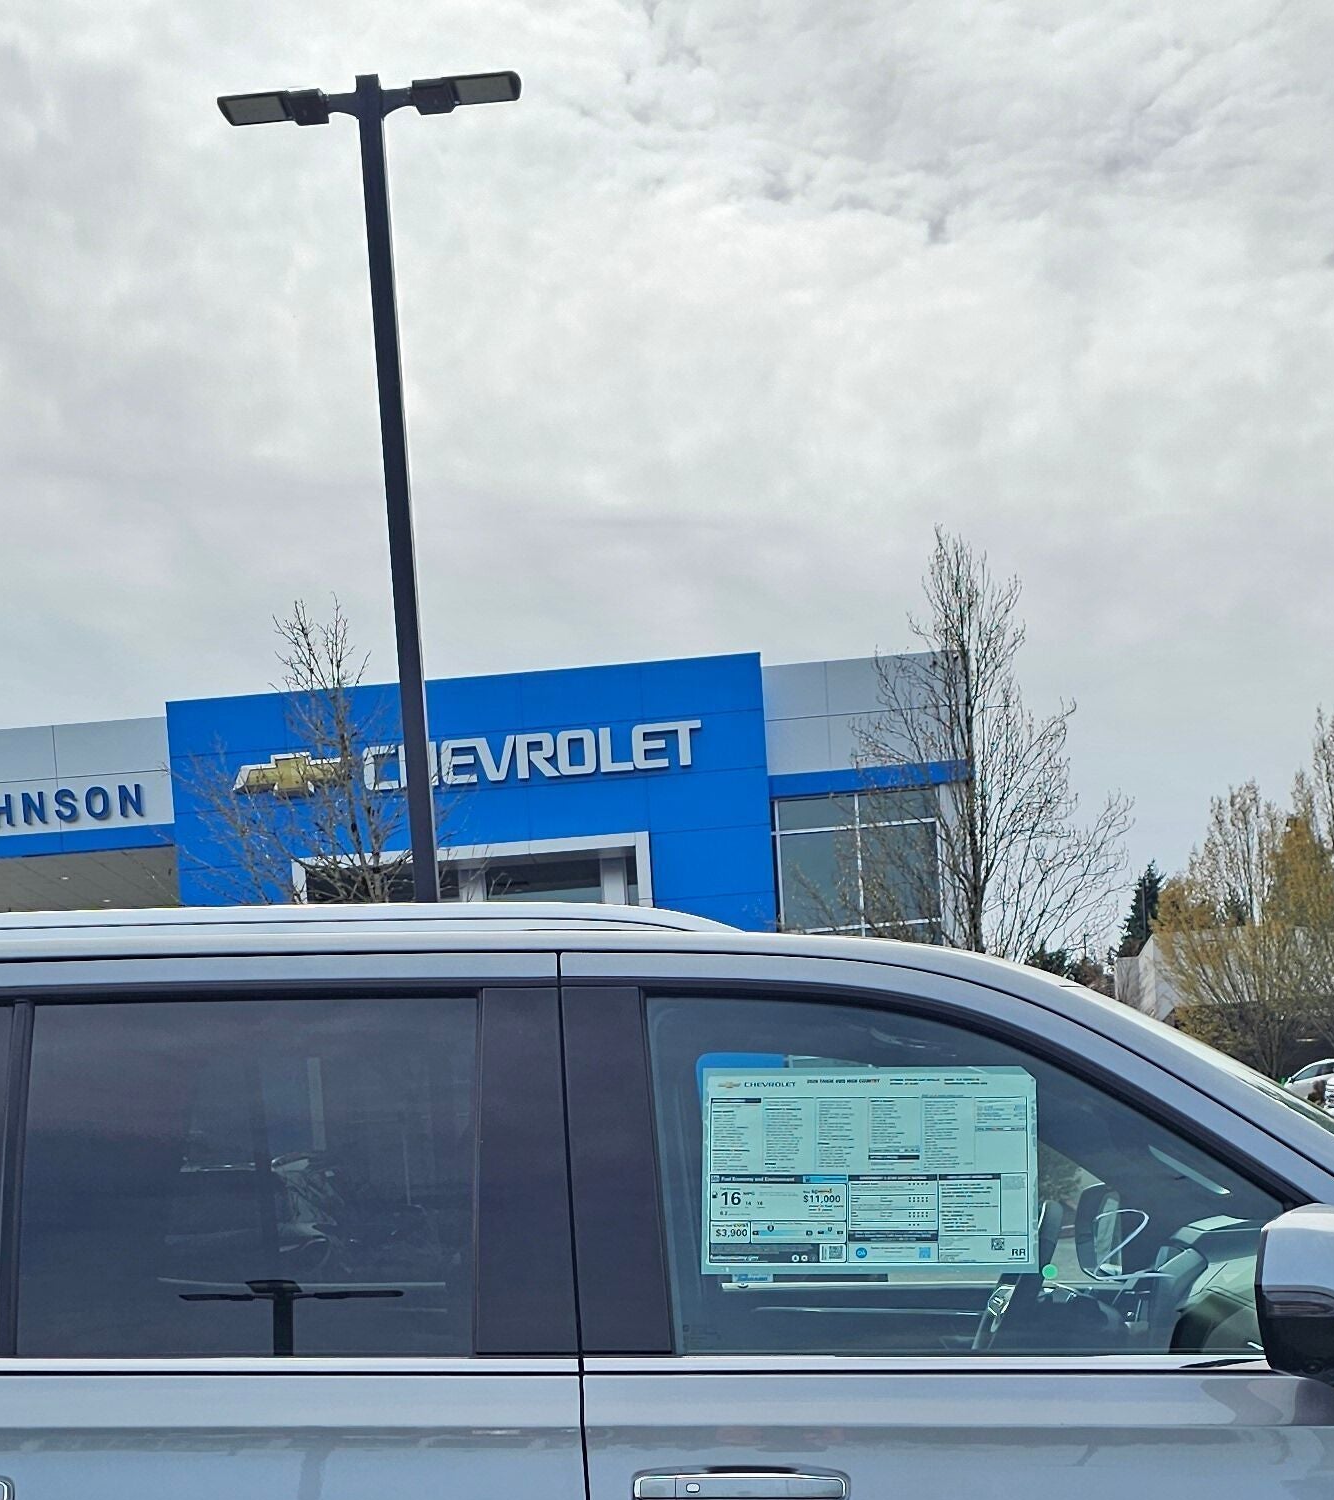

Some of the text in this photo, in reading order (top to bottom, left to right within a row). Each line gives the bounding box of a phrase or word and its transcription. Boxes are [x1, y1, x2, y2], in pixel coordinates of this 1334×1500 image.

[721, 1191, 742, 1206] 16
[803, 1194, 841, 1204] $11,000
[715, 1228, 748, 1238] $3,900
